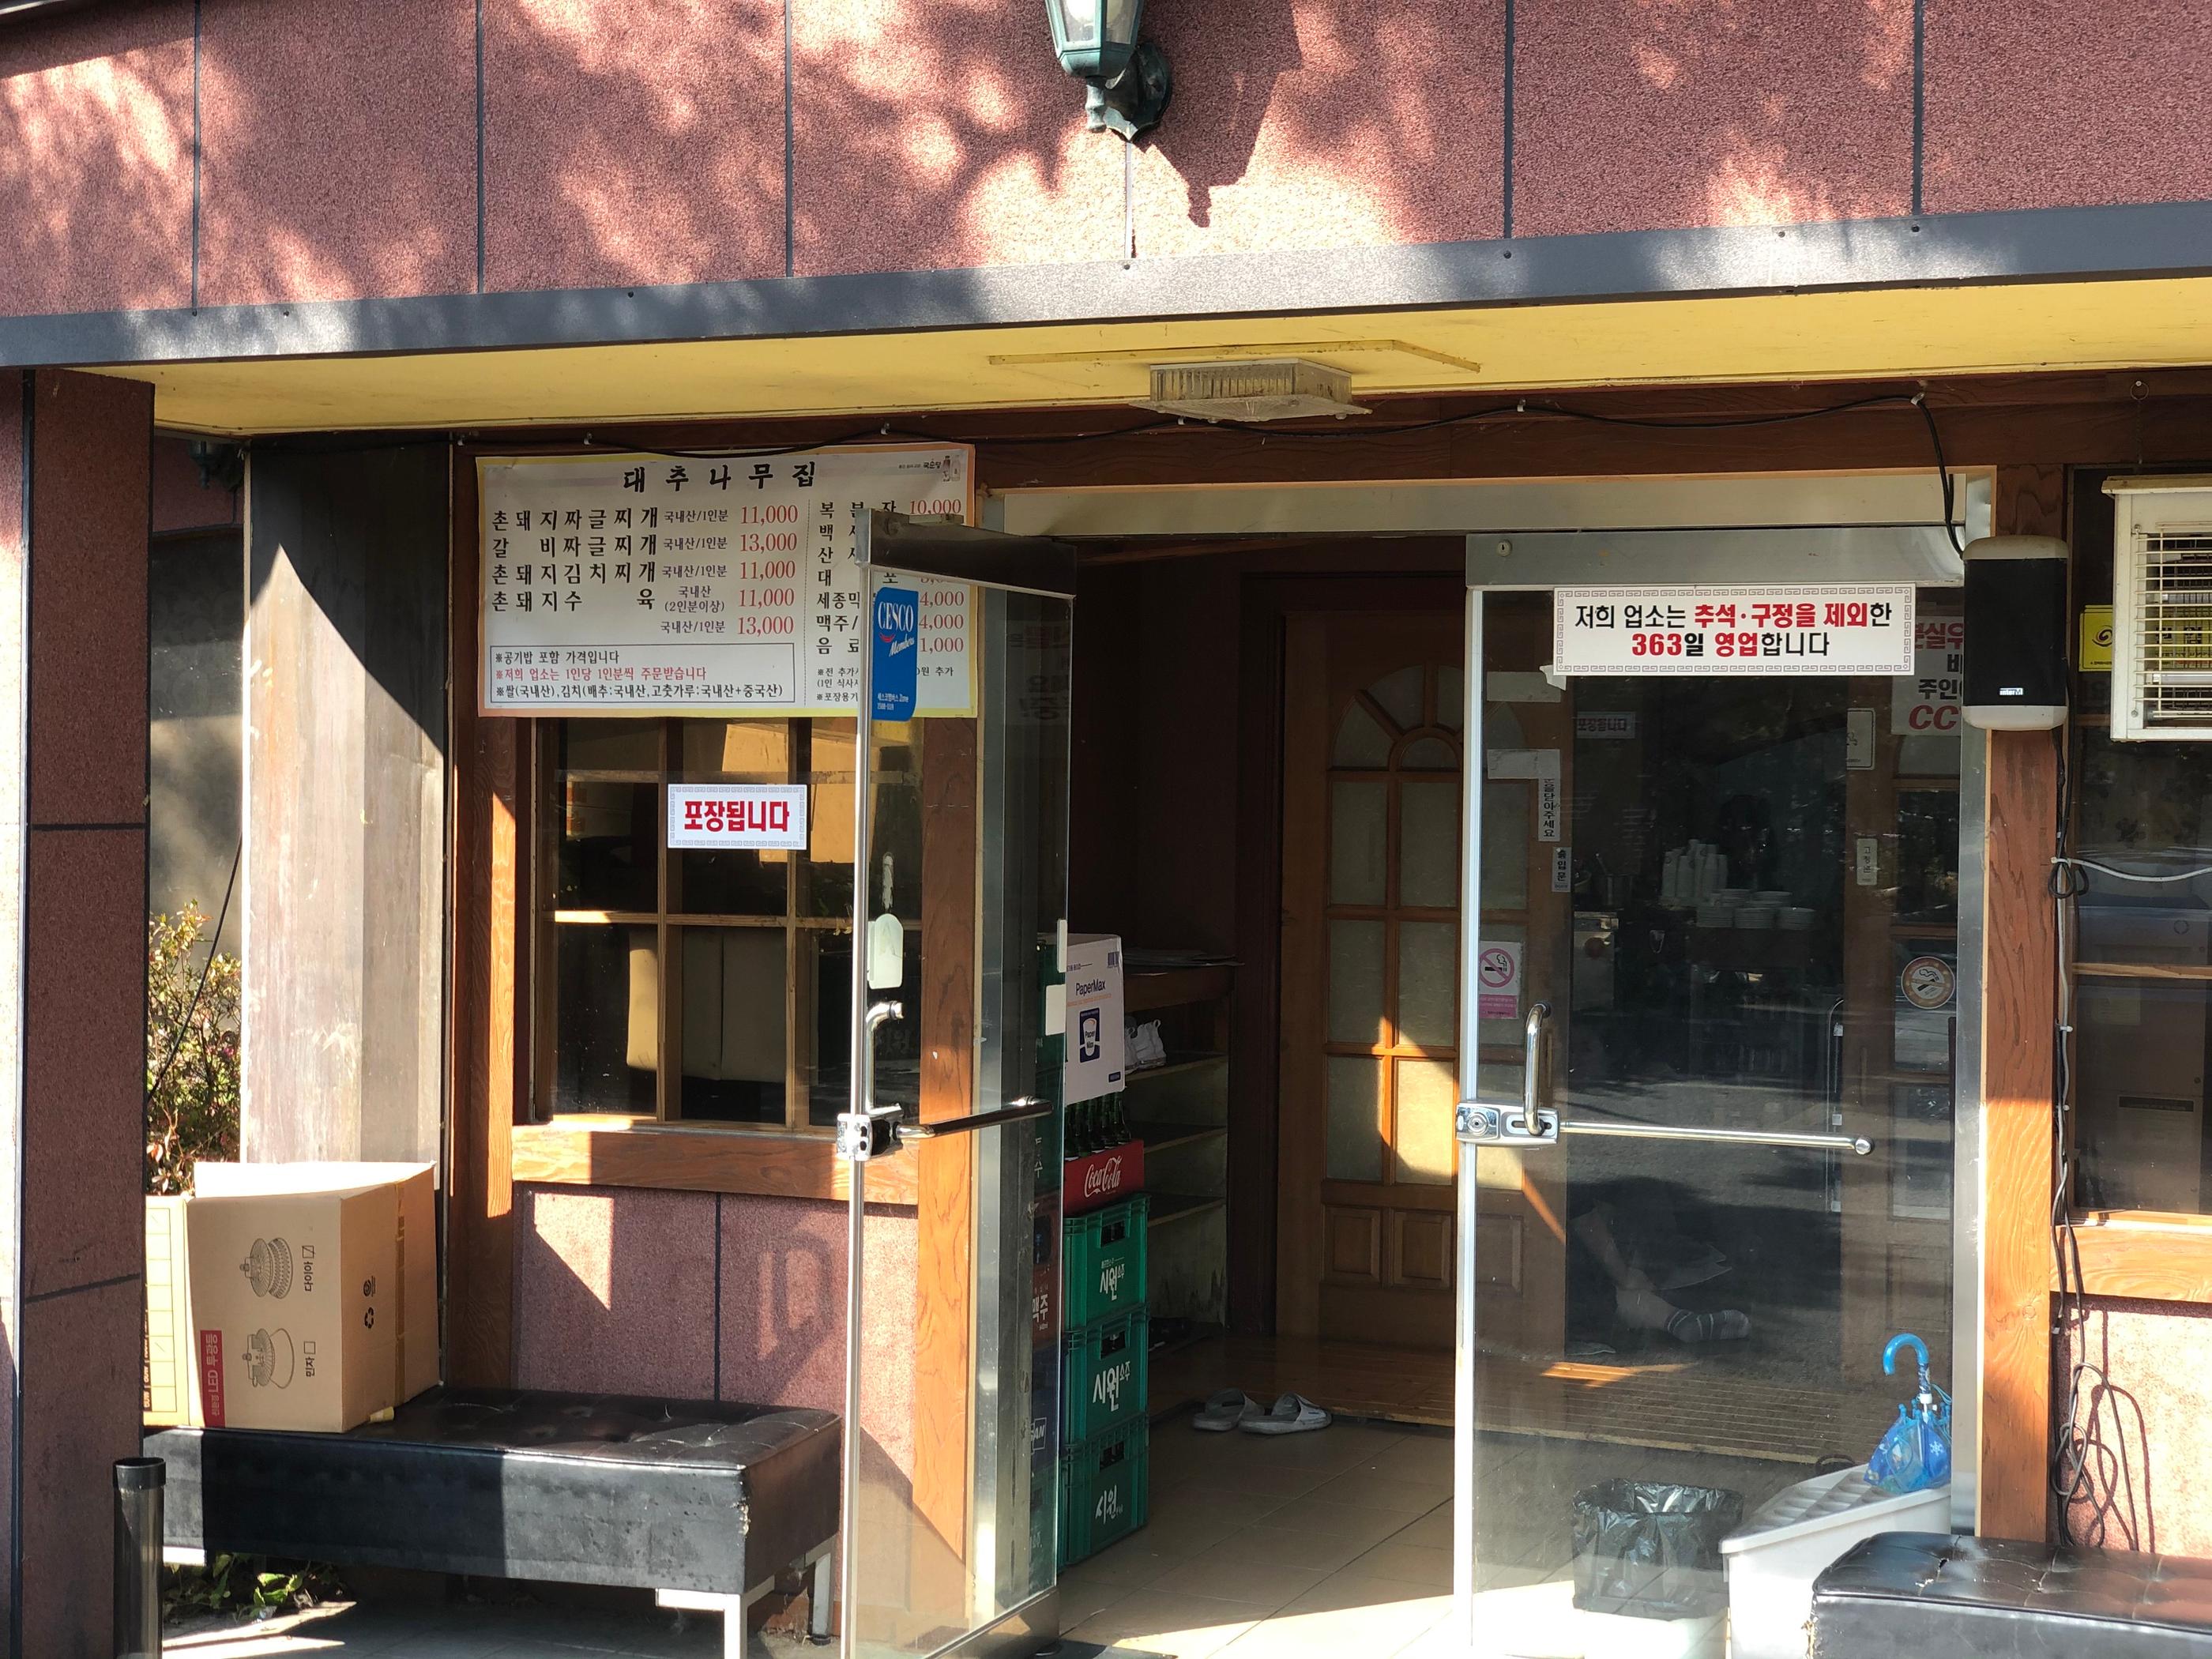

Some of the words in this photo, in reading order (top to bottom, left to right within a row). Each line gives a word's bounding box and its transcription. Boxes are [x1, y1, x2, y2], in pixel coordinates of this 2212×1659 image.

[623, 461, 816, 493] 대추나무집
[664, 508, 728, 524] 국내산/1인분
[740, 504, 799, 525] 11,000
[909, 498, 962, 515] 10,000
[662, 536, 728, 551] 국내산/1인분
[739, 532, 798, 553] 13,000
[661, 564, 728, 580] 국내산/1인분
[739, 560, 797, 581] 11,000
[678, 585, 712, 599] 국내산
[738, 588, 796, 608] 11,000
[817, 592, 861, 610] 세종막
[919, 591, 965, 607] 4,000
[664, 600, 725, 614] (2인분이상)
[1574, 604, 1616, 630] 저희
[1623, 604, 1686, 630] 업소는
[1694, 602, 1818, 629] 추석·구정을
[1823, 602, 1893, 628] 제외한
[736, 615, 795, 637] 13,000
[816, 615, 859, 632] 맥주/
[878, 601, 915, 633] CESCO
[918, 615, 965, 630] 4,000
[660, 621, 726, 635] 국내산/1인분
[920, 637, 965, 653] 1,000
[1631, 632, 1705, 658] 363일
[1714, 631, 1830, 658] 영업합니다
[538, 650, 560, 664] 포함
[566, 650, 619, 664] 가격입니다
[529, 668, 560, 682] 업소는
[566, 668, 592, 682] 1인당
[598, 667, 634, 681] 1인분씩
[641, 666, 706, 681] 주문받습니다
[935, 666, 954, 677] 추가
[1918, 679, 1962, 701] 주인
[1909, 703, 1961, 731] CC
[684, 800, 790, 832] 포장됩니다
[1075, 979, 1106, 996] PaperMax
[303, 1261, 314, 1292] 다이아
[205, 1333, 219, 1367] 투광등
[305, 1358, 316, 1378] 민자
[207, 1369, 219, 1393] LED
